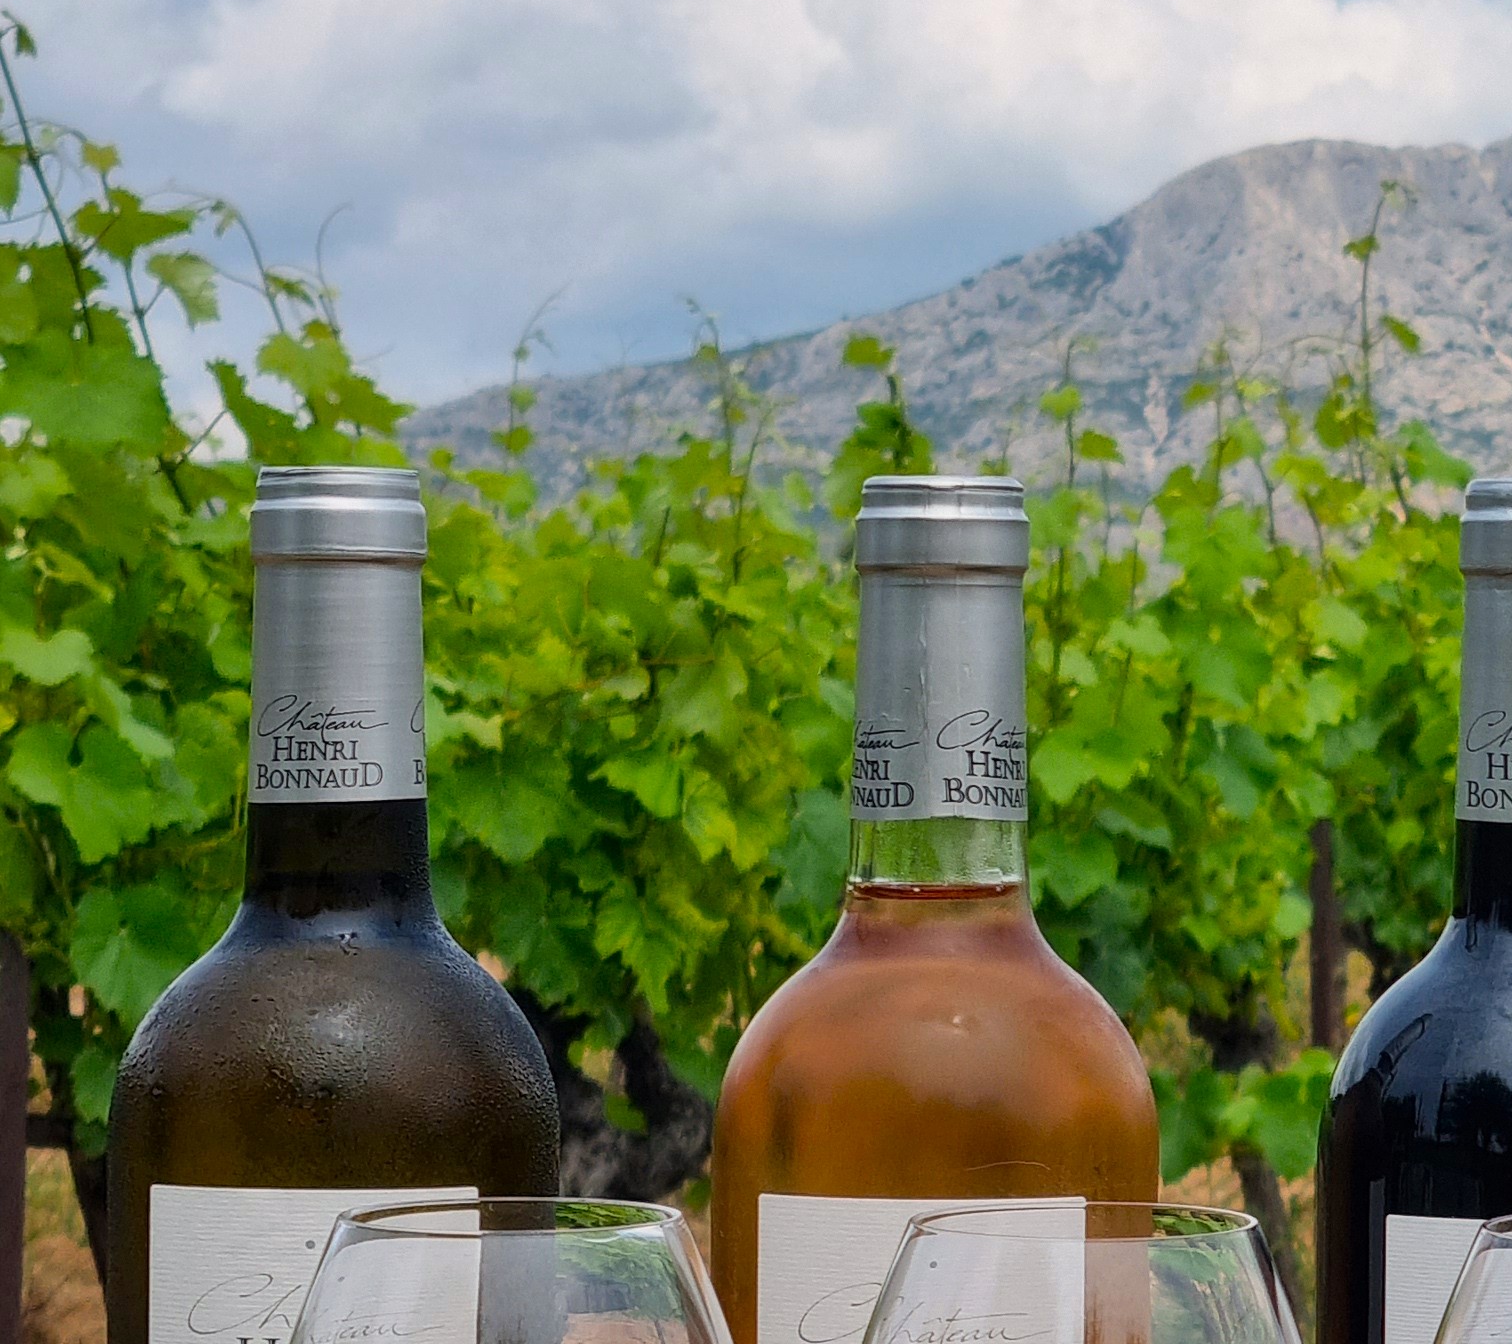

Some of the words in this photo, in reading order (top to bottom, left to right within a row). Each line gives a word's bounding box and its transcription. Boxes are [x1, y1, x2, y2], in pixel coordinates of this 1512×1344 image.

[257, 694, 389, 744] Château
[270, 735, 360, 762] HENRI
[255, 762, 384, 790] BONNAUD
[853, 758, 891, 781] ENRI
